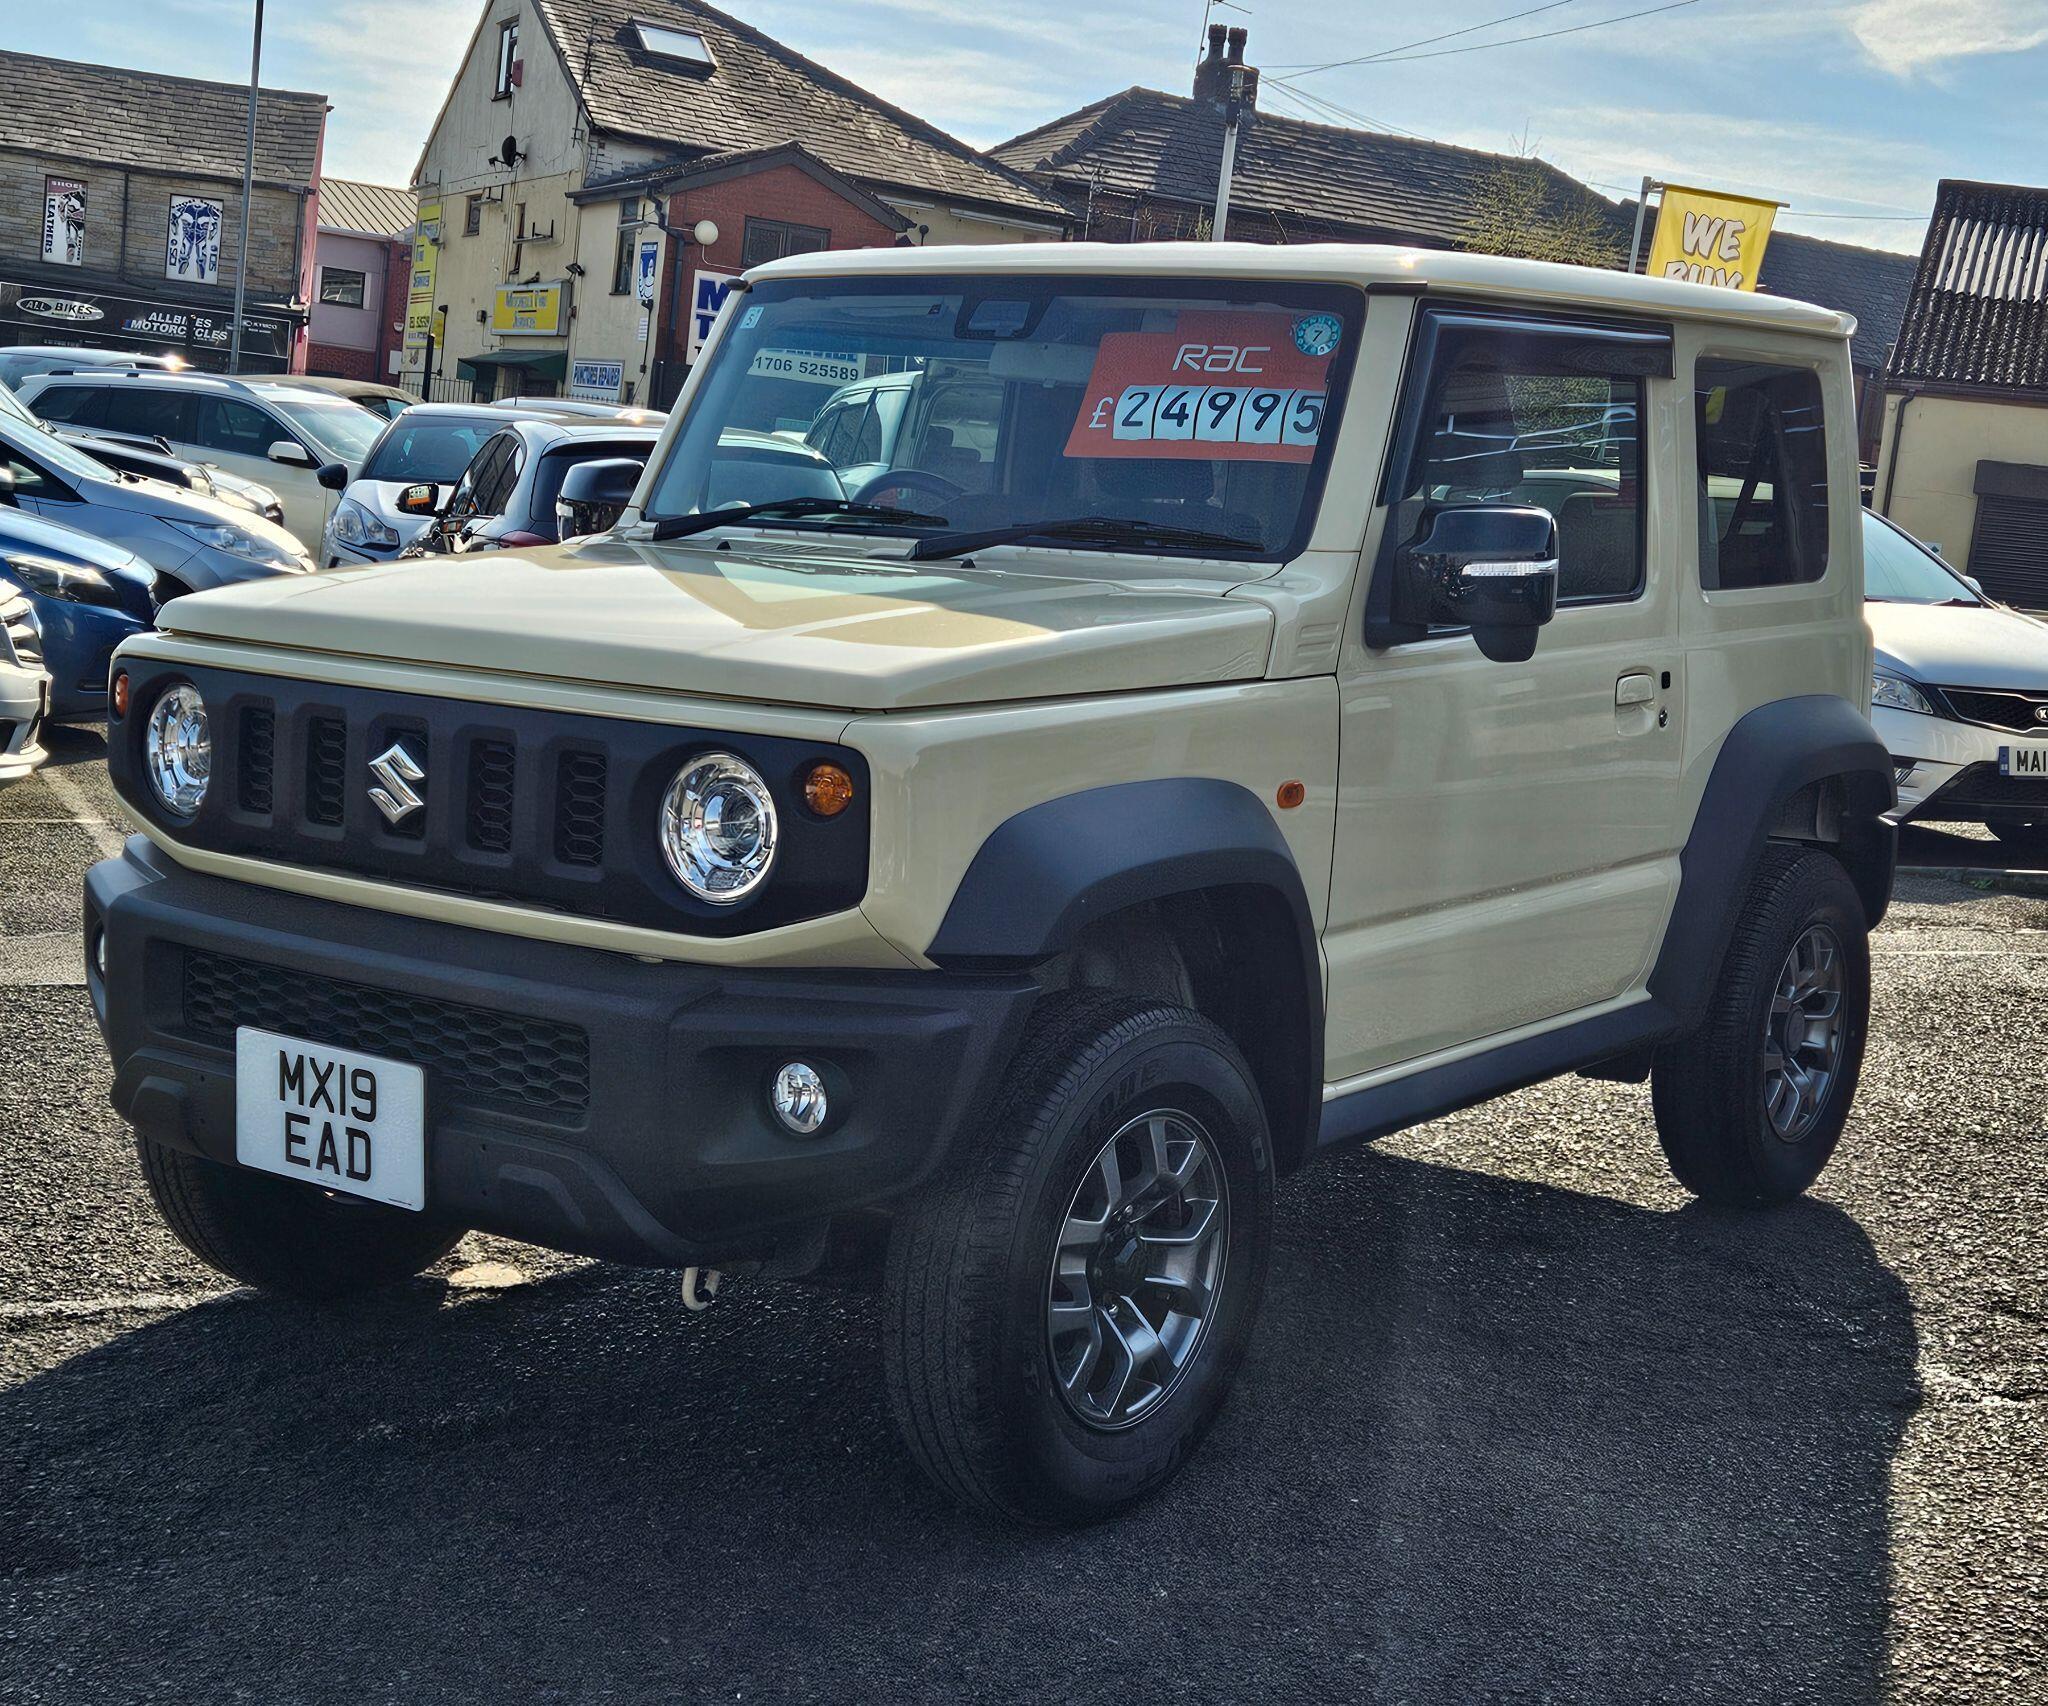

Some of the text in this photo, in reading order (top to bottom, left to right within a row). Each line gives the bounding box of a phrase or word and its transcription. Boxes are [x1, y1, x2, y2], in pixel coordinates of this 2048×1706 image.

[45, 198, 56, 253] LEATHERS
[1682, 211, 1745, 263] WE
[26, 301, 45, 311] ALL
[55, 303, 93, 316] BIKES
[149, 312, 212, 328] ALLBIES
[130, 319, 228, 342] MOTORCCLES
[799, 362, 859, 381] 525589
[279, 1049, 377, 1122] MX19
[285, 1111, 372, 1182] EAD
